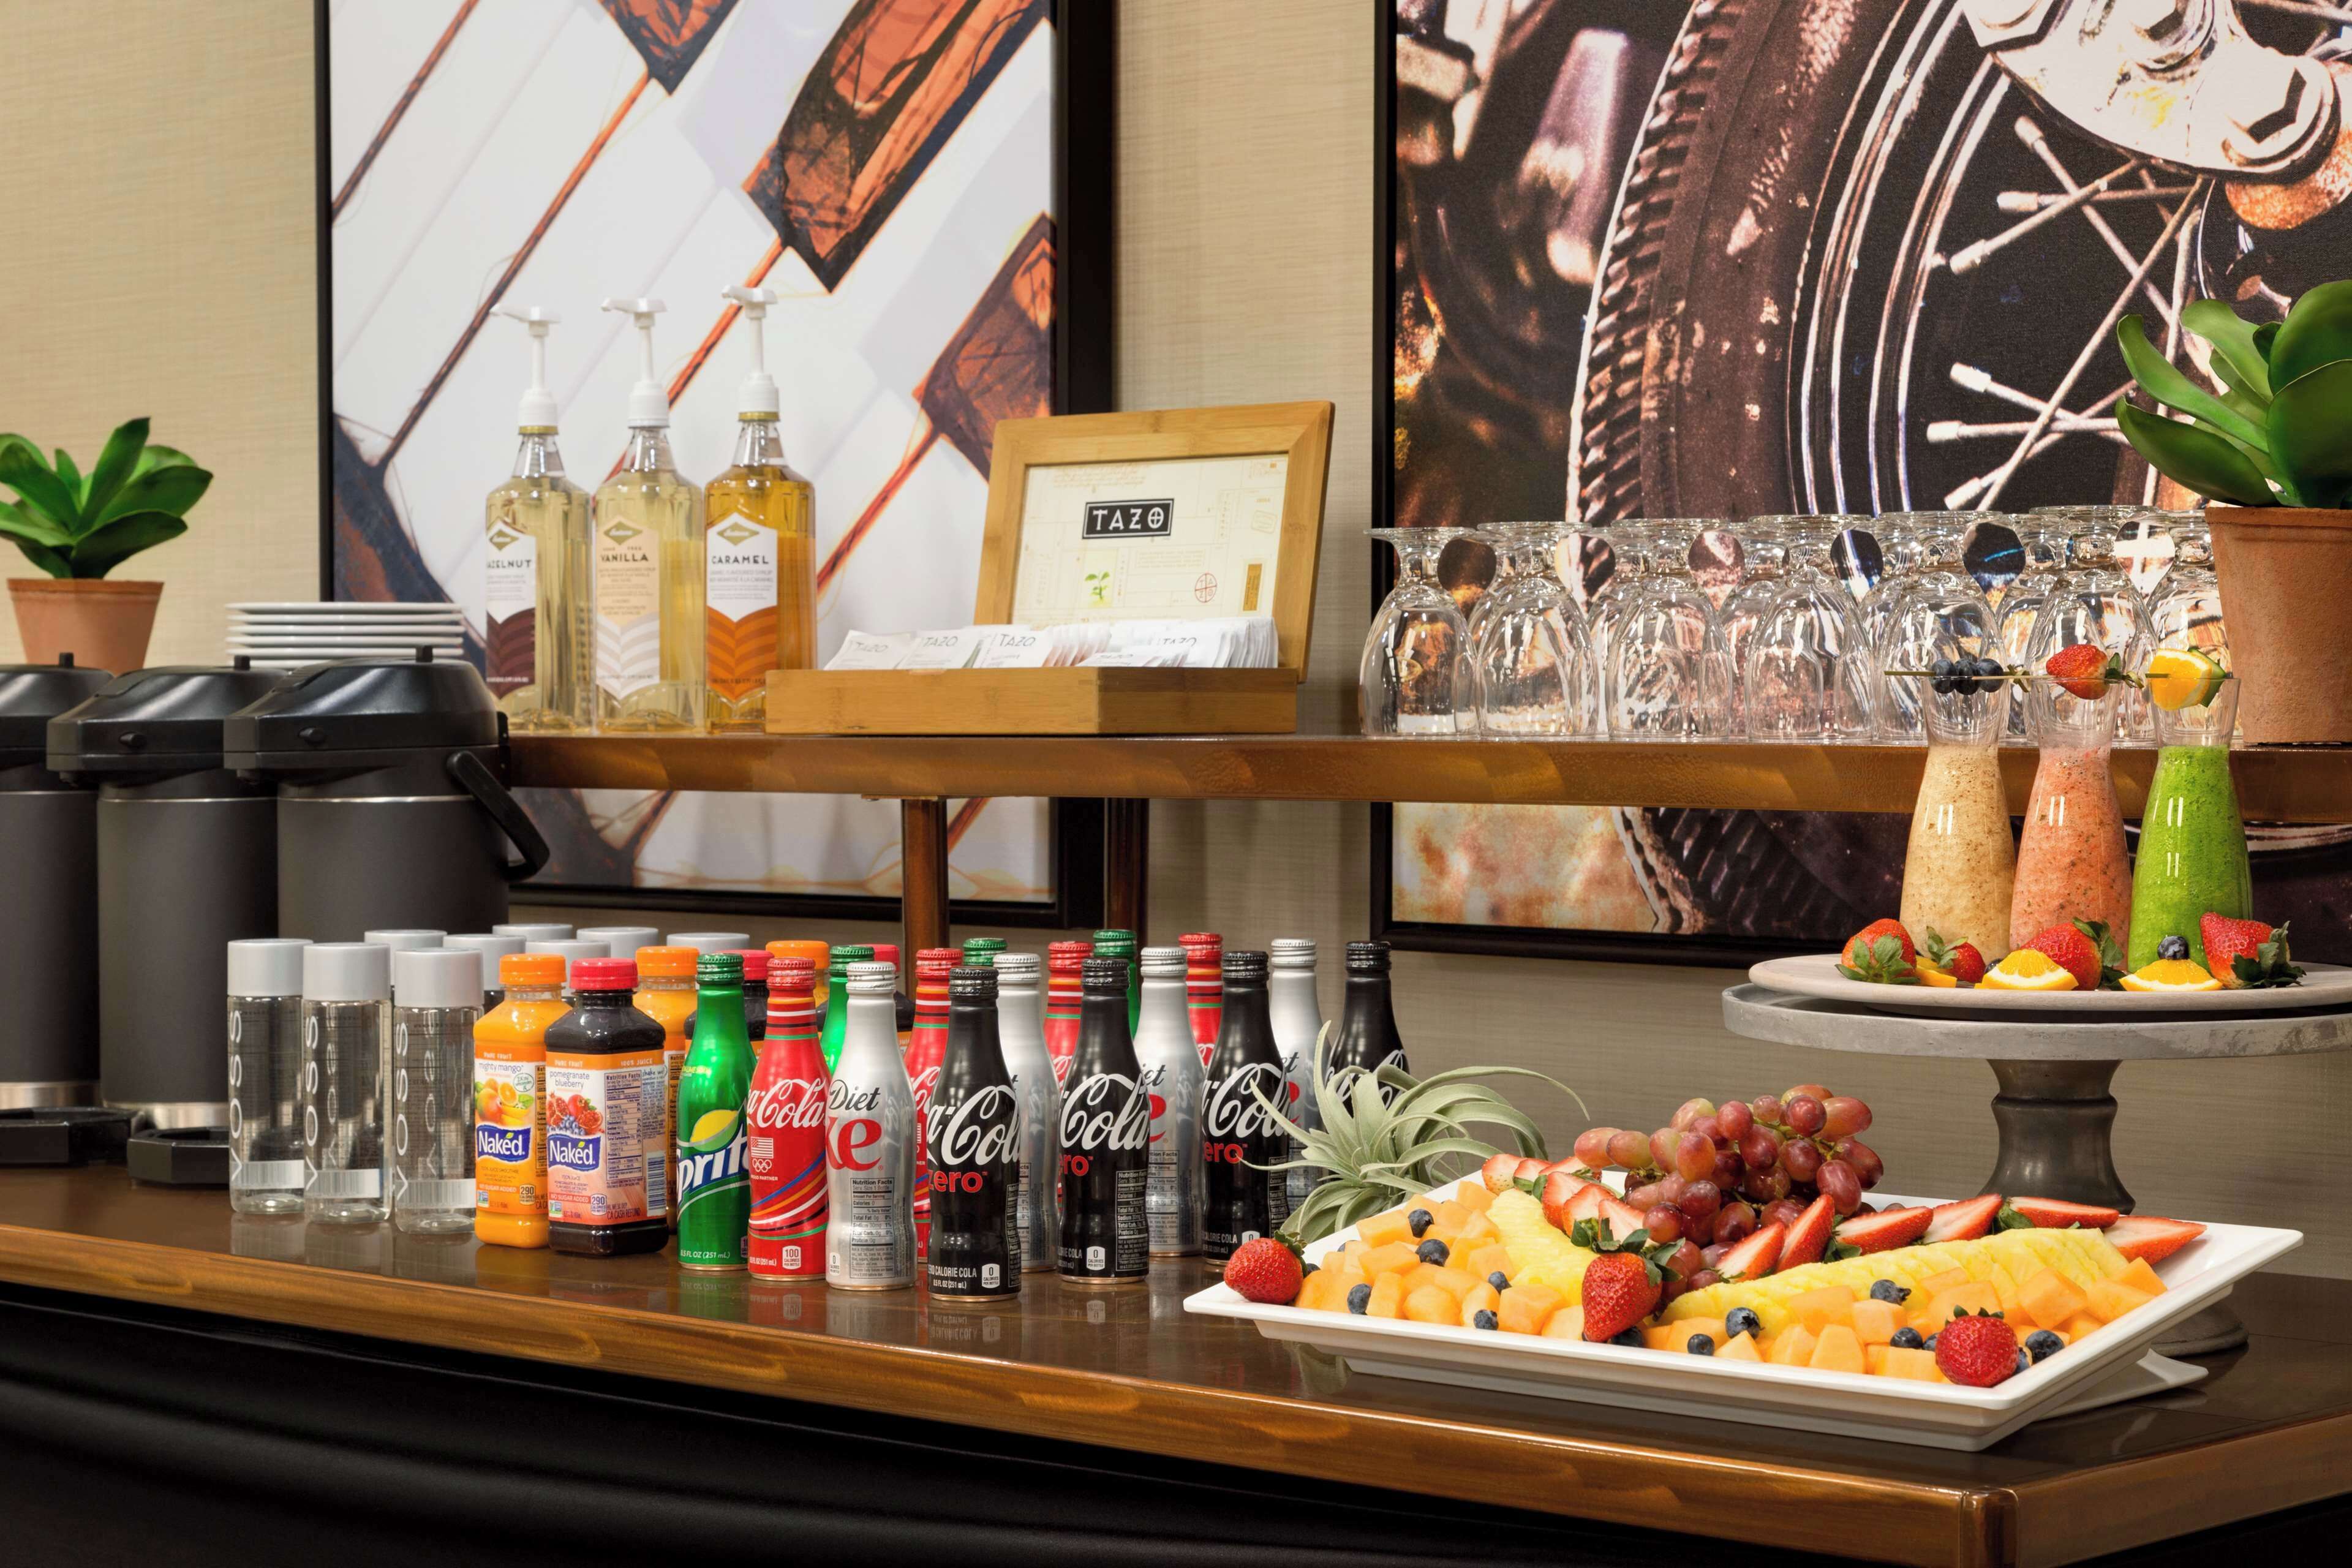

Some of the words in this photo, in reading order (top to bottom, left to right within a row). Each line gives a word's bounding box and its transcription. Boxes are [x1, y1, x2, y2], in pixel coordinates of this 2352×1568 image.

[1092, 507, 1164, 530] TAZO
[600, 553, 649, 562] VANILLA
[711, 555, 769, 564] CARAMEL
[487, 560, 532, 568] AZELNUT
[923, 636, 959, 647] TAZO
[999, 633, 1036, 647] TAZO
[855, 642, 889, 653] TAZO
[479, 1062, 497, 1072] mighty
[498, 1064, 522, 1074] mango
[549, 1071, 590, 1081] pomegranate
[555, 1079, 584, 1088] blueberry
[229, 1009, 243, 1182] VOSS
[828, 1079, 881, 1111] Diet
[306, 1016, 318, 1191] VOSS
[747, 1078, 826, 1128] a-Cola
[396, 1022, 409, 1201] VOSS
[478, 1130, 522, 1156] Naked
[549, 1140, 593, 1165] Naked
[1204, 1142, 1243, 1164] ero
[677, 1123, 748, 1204] prit
[520, 1186, 535, 1195] 290
[592, 1196, 605, 1205] 290
[607, 1210, 613, 1219] CA
[614, 1209, 625, 1218] CASH
[625, 1207, 641, 1217] REFUND
[1221, 1233, 1237, 1244] COLA
[785, 1248, 799, 1258] 100
[1068, 1248, 1082, 1259] COLA
[1093, 1249, 1098, 1258] 0
[935, 1265, 958, 1277] CALORIE
[959, 1267, 978, 1278] COLA
[989, 1267, 993, 1276] 0
[948, 1280, 957, 1289] (251
[957, 1281, 967, 1289] mL)
